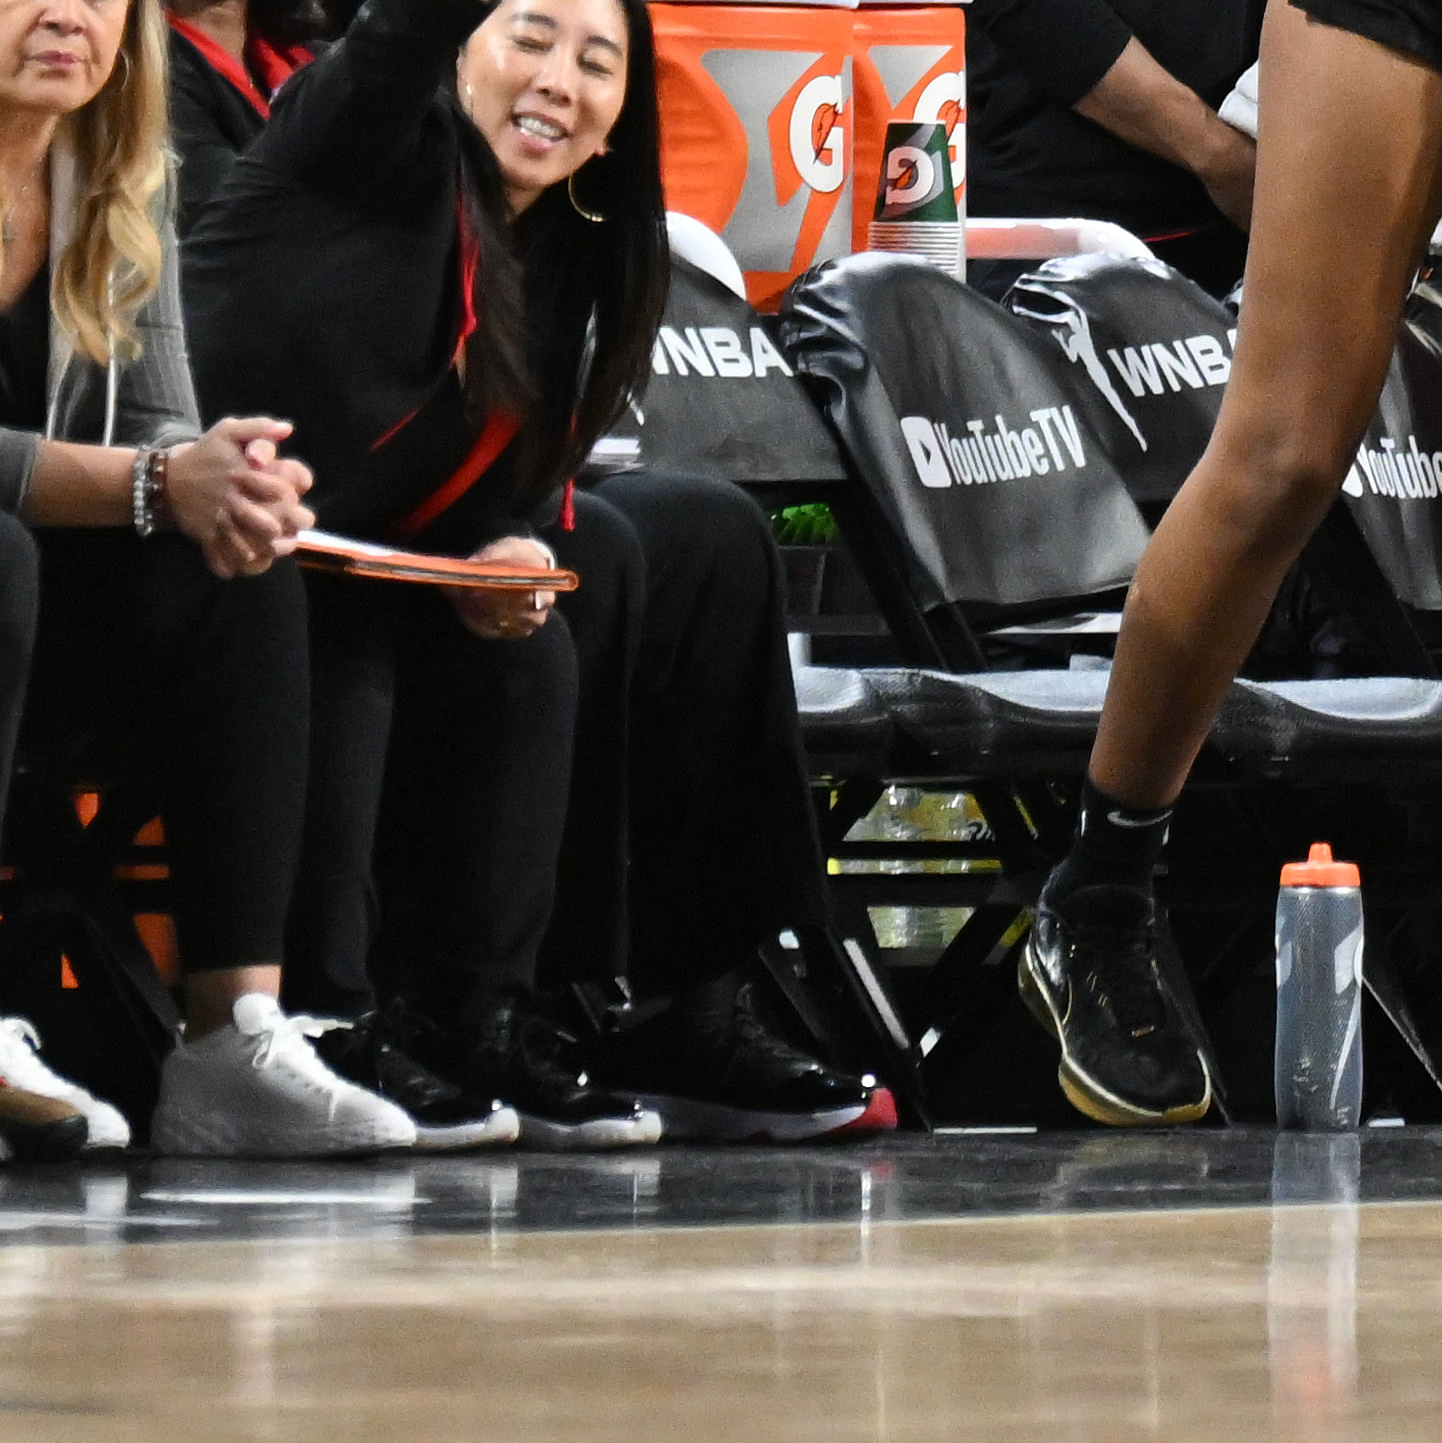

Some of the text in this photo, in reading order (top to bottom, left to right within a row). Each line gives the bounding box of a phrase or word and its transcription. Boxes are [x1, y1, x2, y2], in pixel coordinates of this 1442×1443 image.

[789, 74, 844, 194] G
[651, 327, 795, 378] NBA
[1107, 328, 1237, 397] WNB
